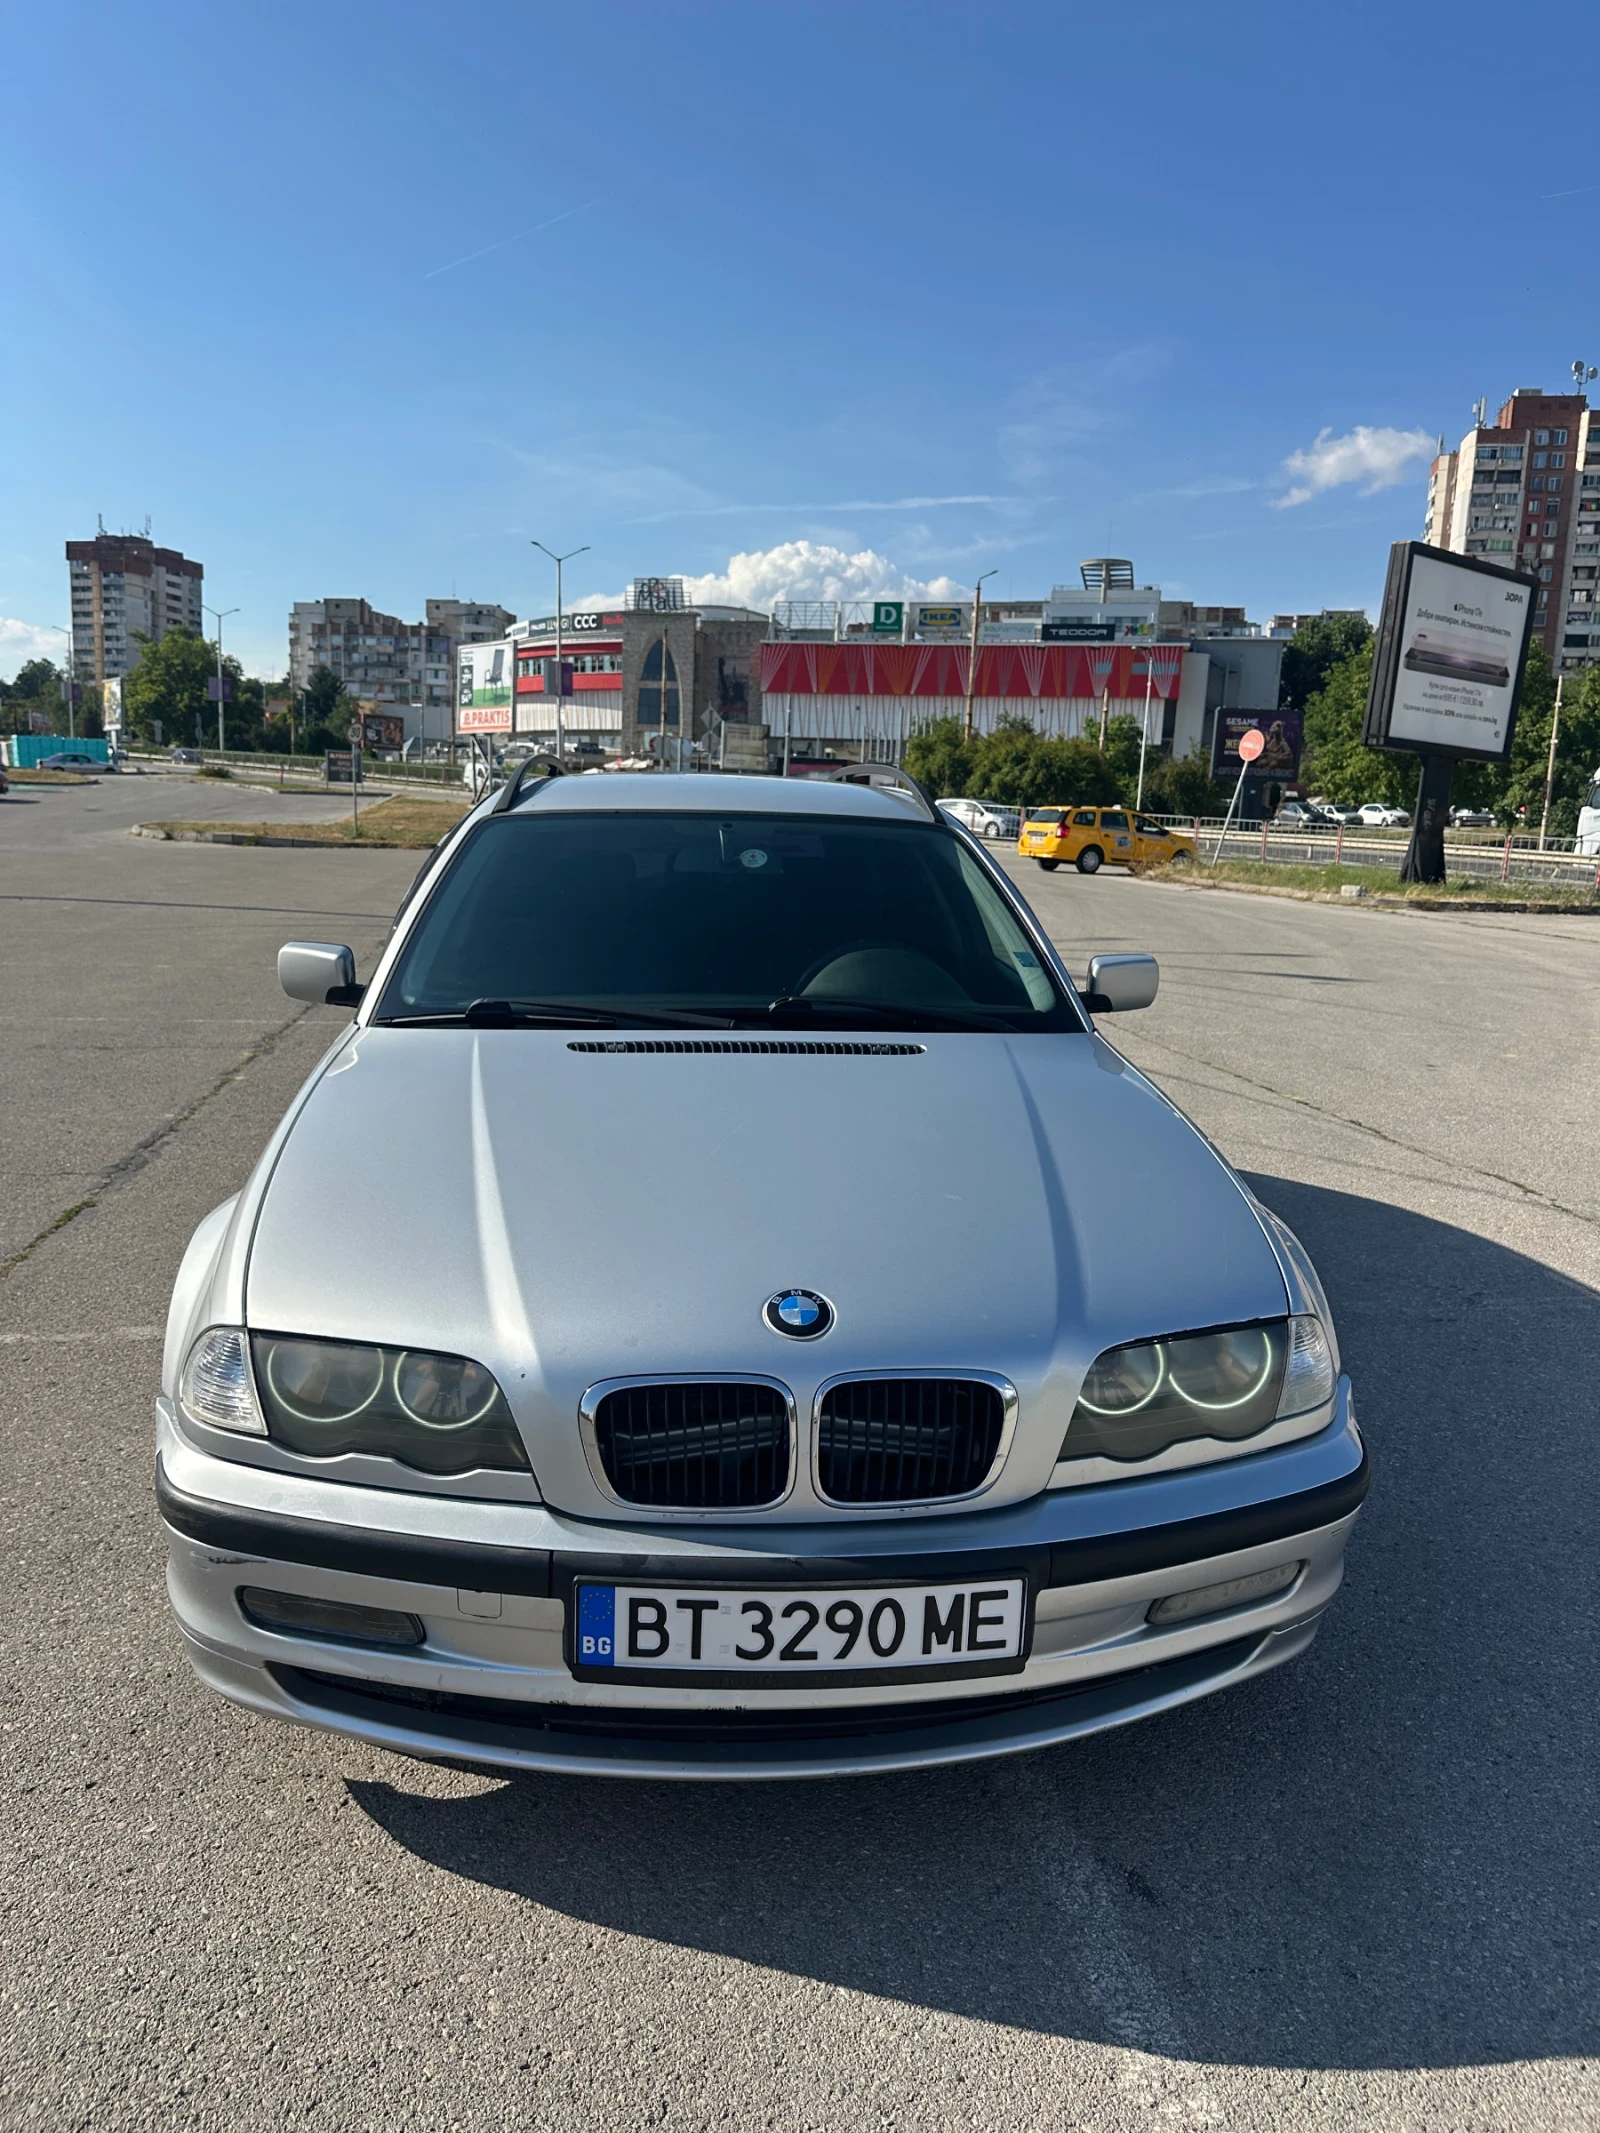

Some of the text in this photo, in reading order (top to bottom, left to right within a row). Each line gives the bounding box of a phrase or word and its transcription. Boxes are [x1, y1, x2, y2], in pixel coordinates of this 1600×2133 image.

[574, 614, 598, 629] CCC
[922, 612, 958, 621] IKEA
[472, 710, 510, 726] PRAKTIS
[1225, 717, 1259, 727] SESAME
[350, 726, 361, 739] 30
[771, 1290, 825, 1305] BMW
[628, 1589, 1009, 1662] BT 3290 ME
[581, 1635, 612, 1656] BG
